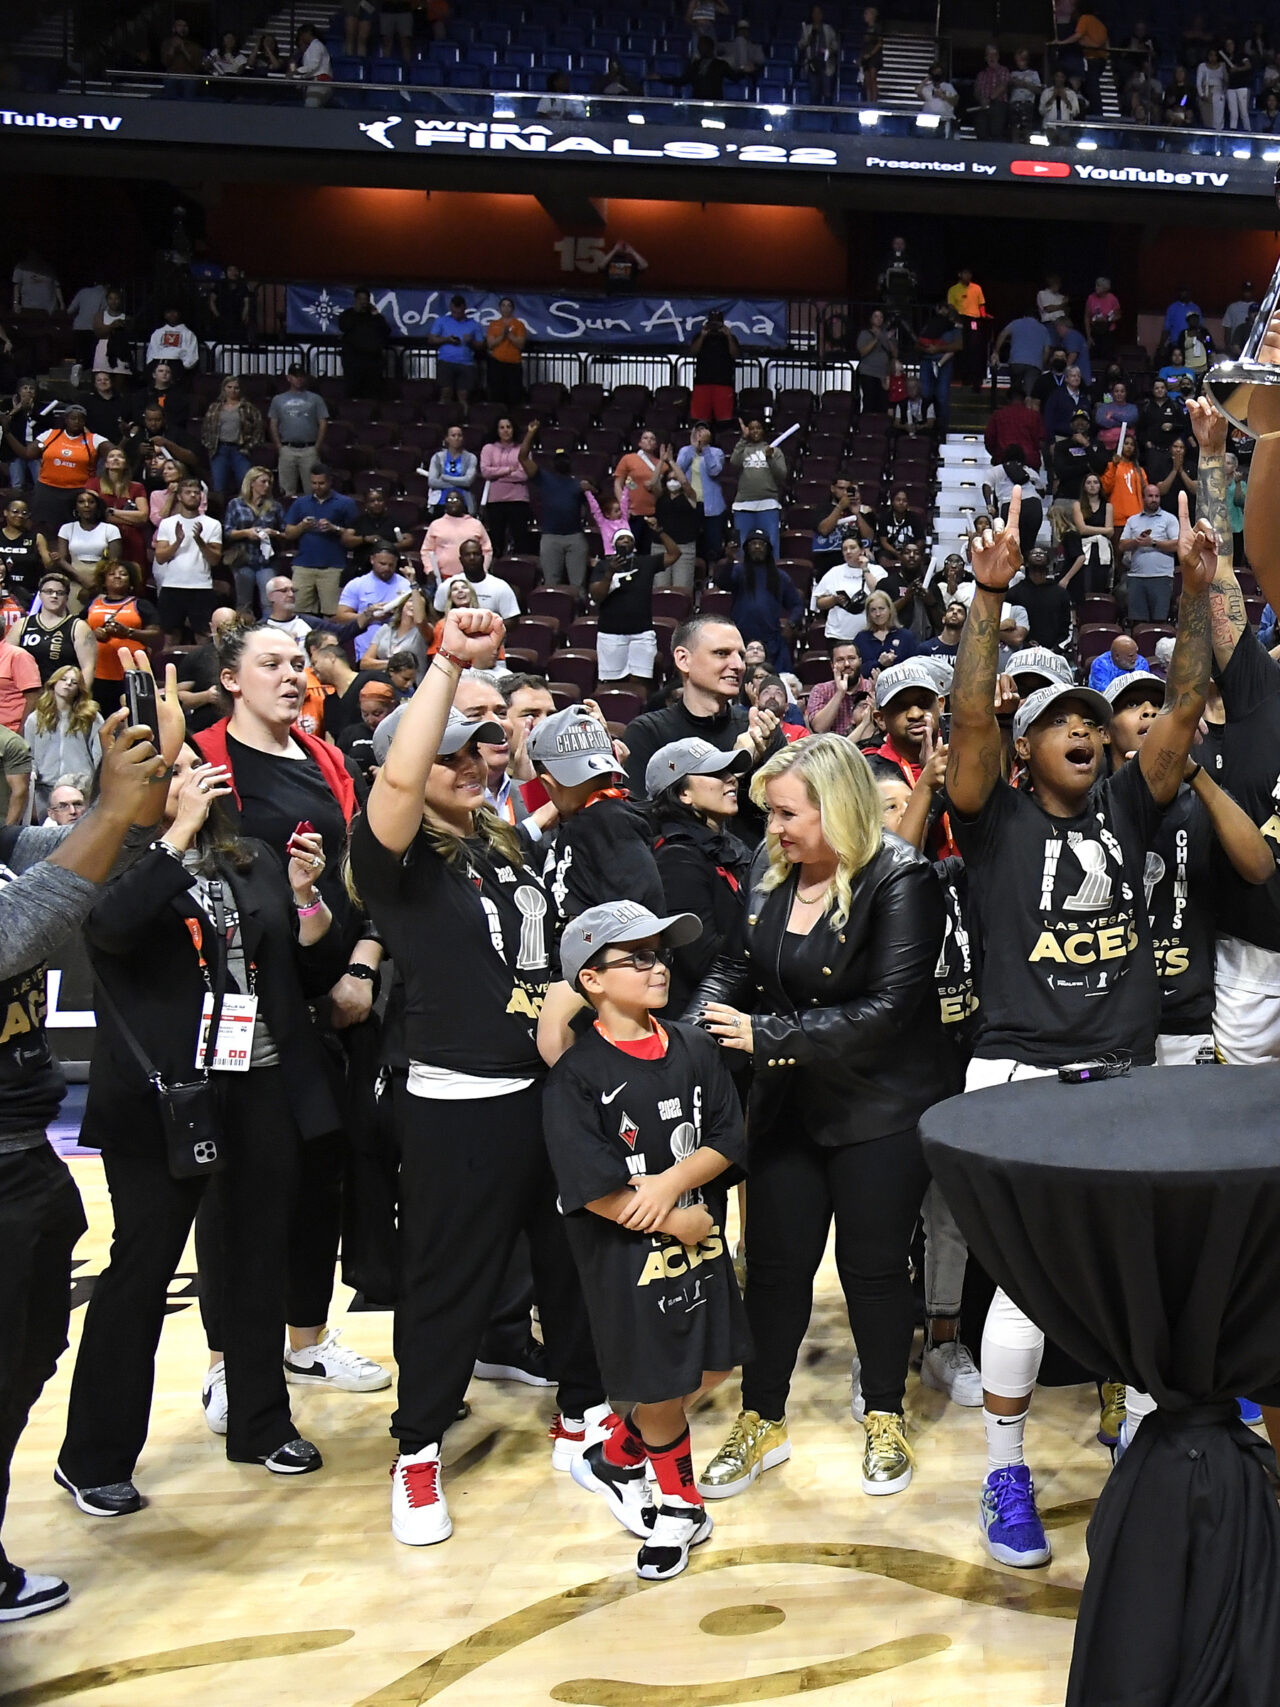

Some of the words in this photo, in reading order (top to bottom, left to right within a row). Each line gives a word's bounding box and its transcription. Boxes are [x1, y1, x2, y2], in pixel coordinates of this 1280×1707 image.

[414, 119, 553, 135] WNBA
[866, 157, 965, 173] Presented
[972, 162, 997, 175] by
[554, 237, 605, 272] 15
[546, 301, 631, 338] Sun
[640, 300, 774, 342] Arna
[22, 633, 41, 646] 10
[49, 630, 63, 660] ACES
[1039, 839, 1063, 911] WNBA
[1172, 829, 1189, 930] CHAMPS
[1044, 919, 1079, 931] LAS
[1028, 920, 1139, 965] ACES
[657, 1097, 682, 1121] 2022
